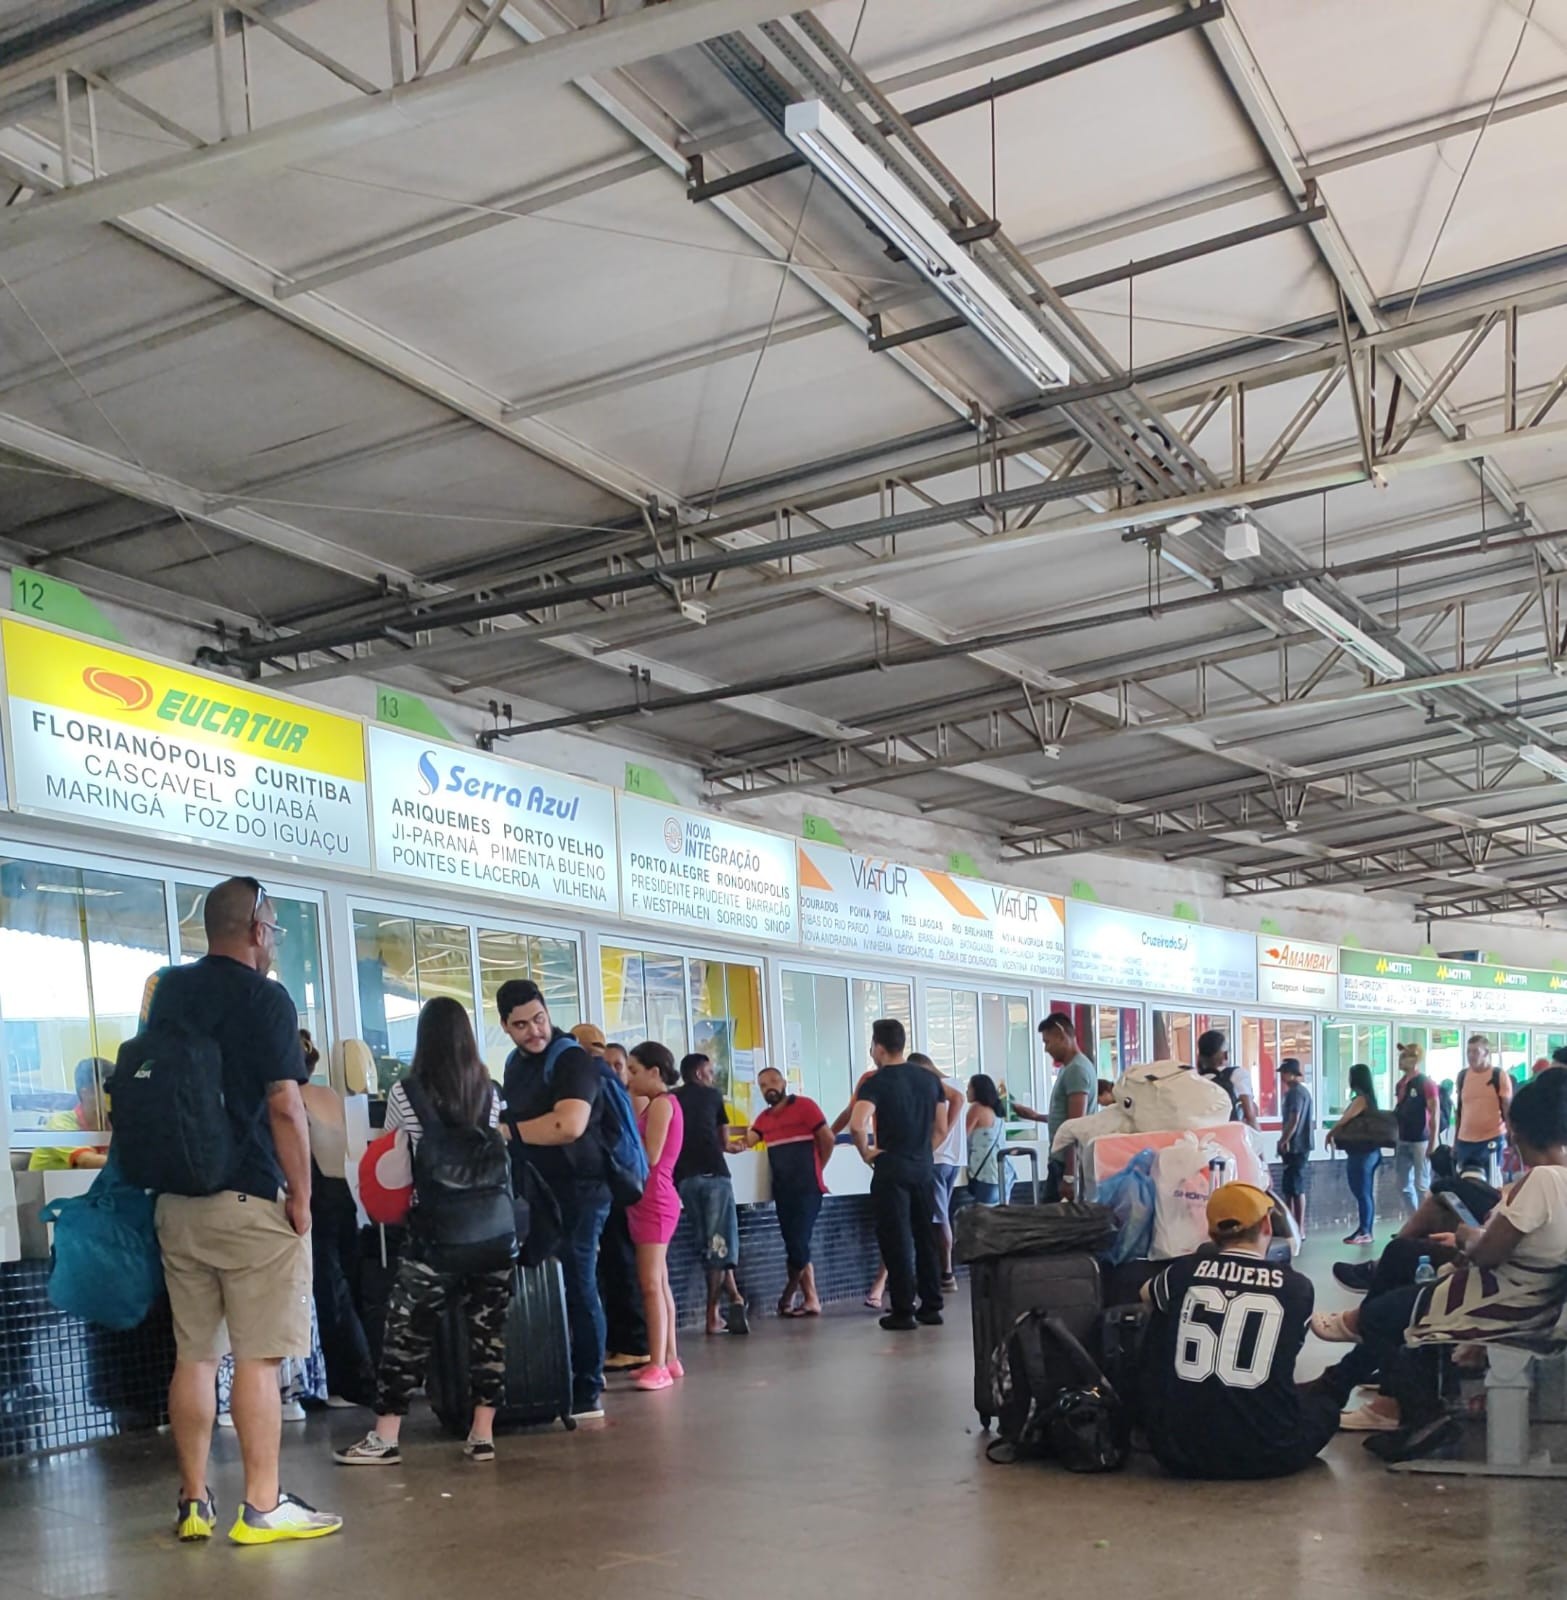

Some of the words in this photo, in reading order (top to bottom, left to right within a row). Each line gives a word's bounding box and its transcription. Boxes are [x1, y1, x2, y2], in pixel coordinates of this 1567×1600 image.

[18, 579, 44, 611] 12
[156, 689, 309, 752] EUCATUR
[381, 695, 399, 718] 13
[33, 710, 236, 778] FLORIANÓPOLIS
[255, 766, 351, 804] CURITIBA
[85, 754, 222, 803] CASCAVEL
[235, 788, 318, 823] CUIABÁ
[446, 765, 522, 810] Serra
[526, 786, 580, 822] Azul
[628, 769, 640, 788] 14
[46, 774, 165, 818] MARINGÁ
[185, 804, 229, 831] FOZ
[236, 814, 266, 838] DO
[273, 822, 349, 855] IGUAÇU
[392, 798, 490, 835] ARIQUEMES
[503, 823, 554, 849] PORTO
[558, 836, 604, 860] VELHO
[686, 822, 711, 841] NOVA
[805, 819, 815, 835] 15
[392, 823, 479, 856] JI-PARANÁ
[491, 843, 555, 871] PIMENTA
[559, 859, 605, 881] BUENO
[631, 853, 667, 874] PORTO
[669, 862, 709, 883] ALEGRE
[685, 840, 760, 872] INTEGRAÇÃO
[393, 847, 457, 874] PONTES
[462, 860, 470, 876] E
[475, 864, 540, 890] LACERDA
[553, 878, 607, 902] VILHENA
[631, 873, 690, 899] PRESIDENTE
[693, 886, 740, 909] PRUDENTE
[642, 895, 710, 921] WESTPHALEN
[717, 908, 758, 929] SORRISO
[764, 918, 791, 934] SINOP
[850, 905, 870, 919] PONTA
[1193, 1259, 1284, 1289] RAIDERS
[1174, 1285, 1284, 1389] 60
